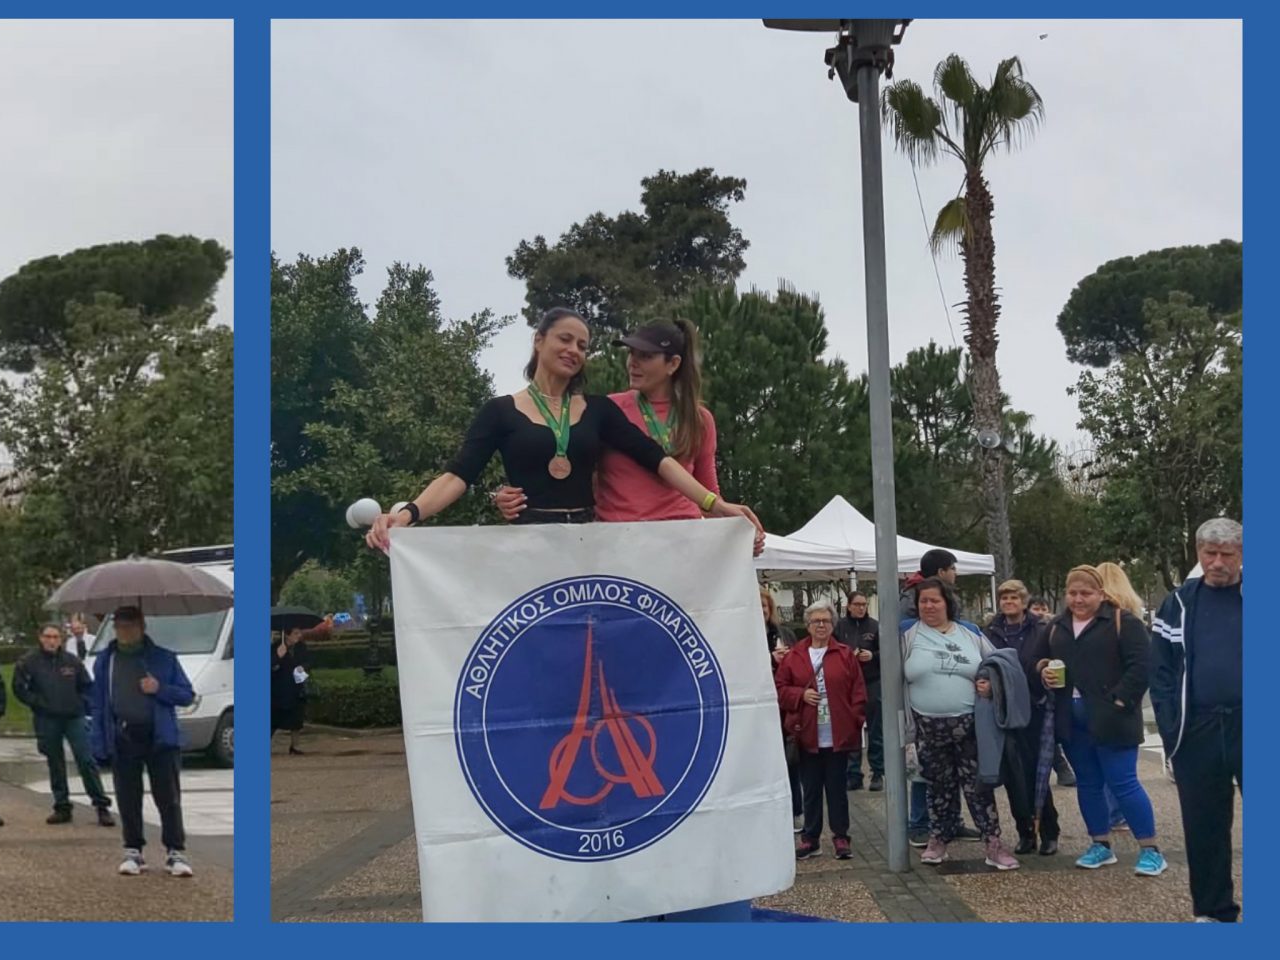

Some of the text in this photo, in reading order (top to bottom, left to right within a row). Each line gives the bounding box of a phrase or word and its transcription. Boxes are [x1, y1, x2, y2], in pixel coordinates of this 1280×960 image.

[465, 583, 714, 700] ΑΘΛΗΤΙΚΟΣ ΟΜΙΛΟΣ ΦΙΛΙΑΤΡΩΝ
[578, 830, 626, 854] 2016
